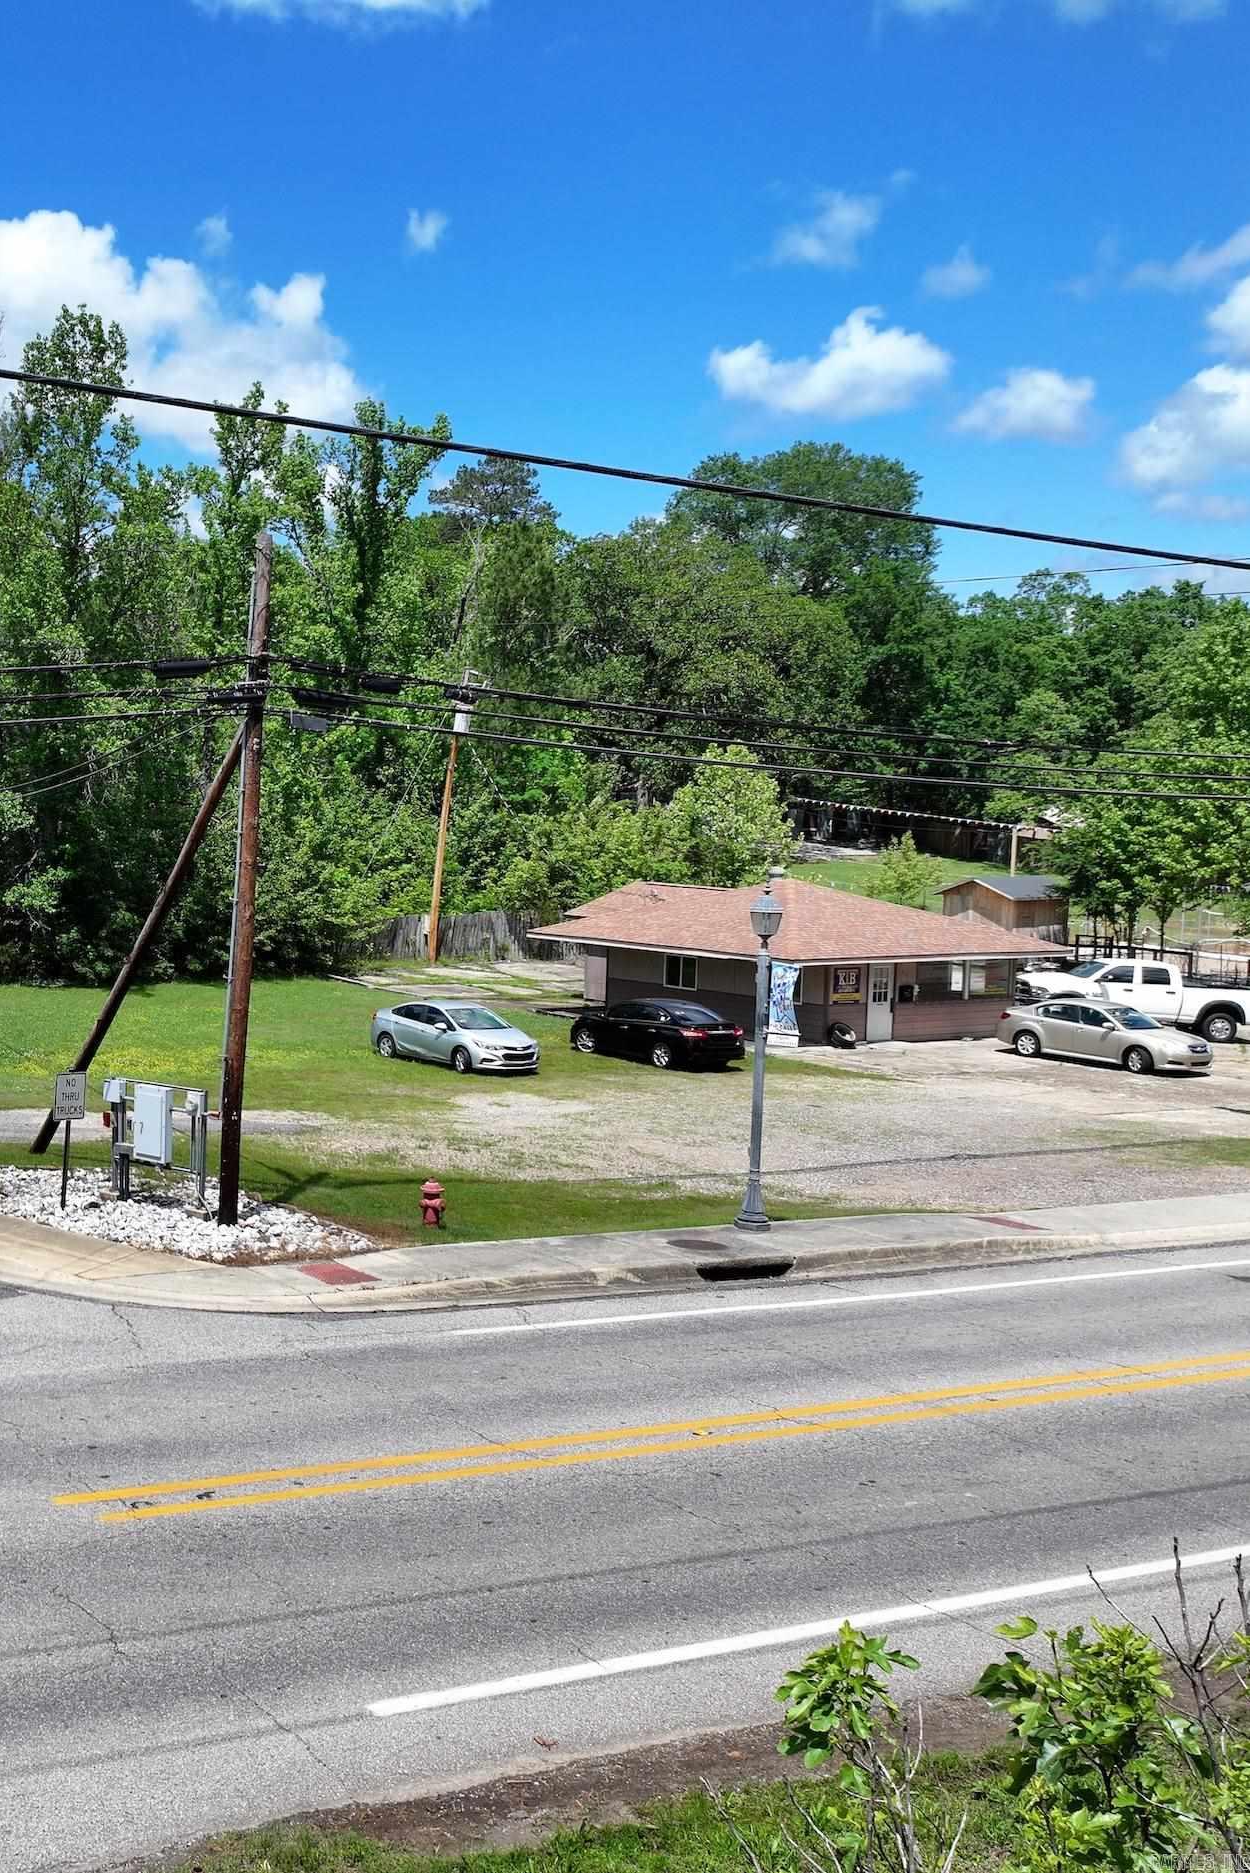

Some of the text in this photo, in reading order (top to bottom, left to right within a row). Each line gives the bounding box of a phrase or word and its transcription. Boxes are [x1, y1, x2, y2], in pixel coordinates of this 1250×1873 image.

[65, 1078, 77, 1088] NO
[61, 1091, 80, 1102] THRU
[56, 1105, 83, 1115] TRUCKS
